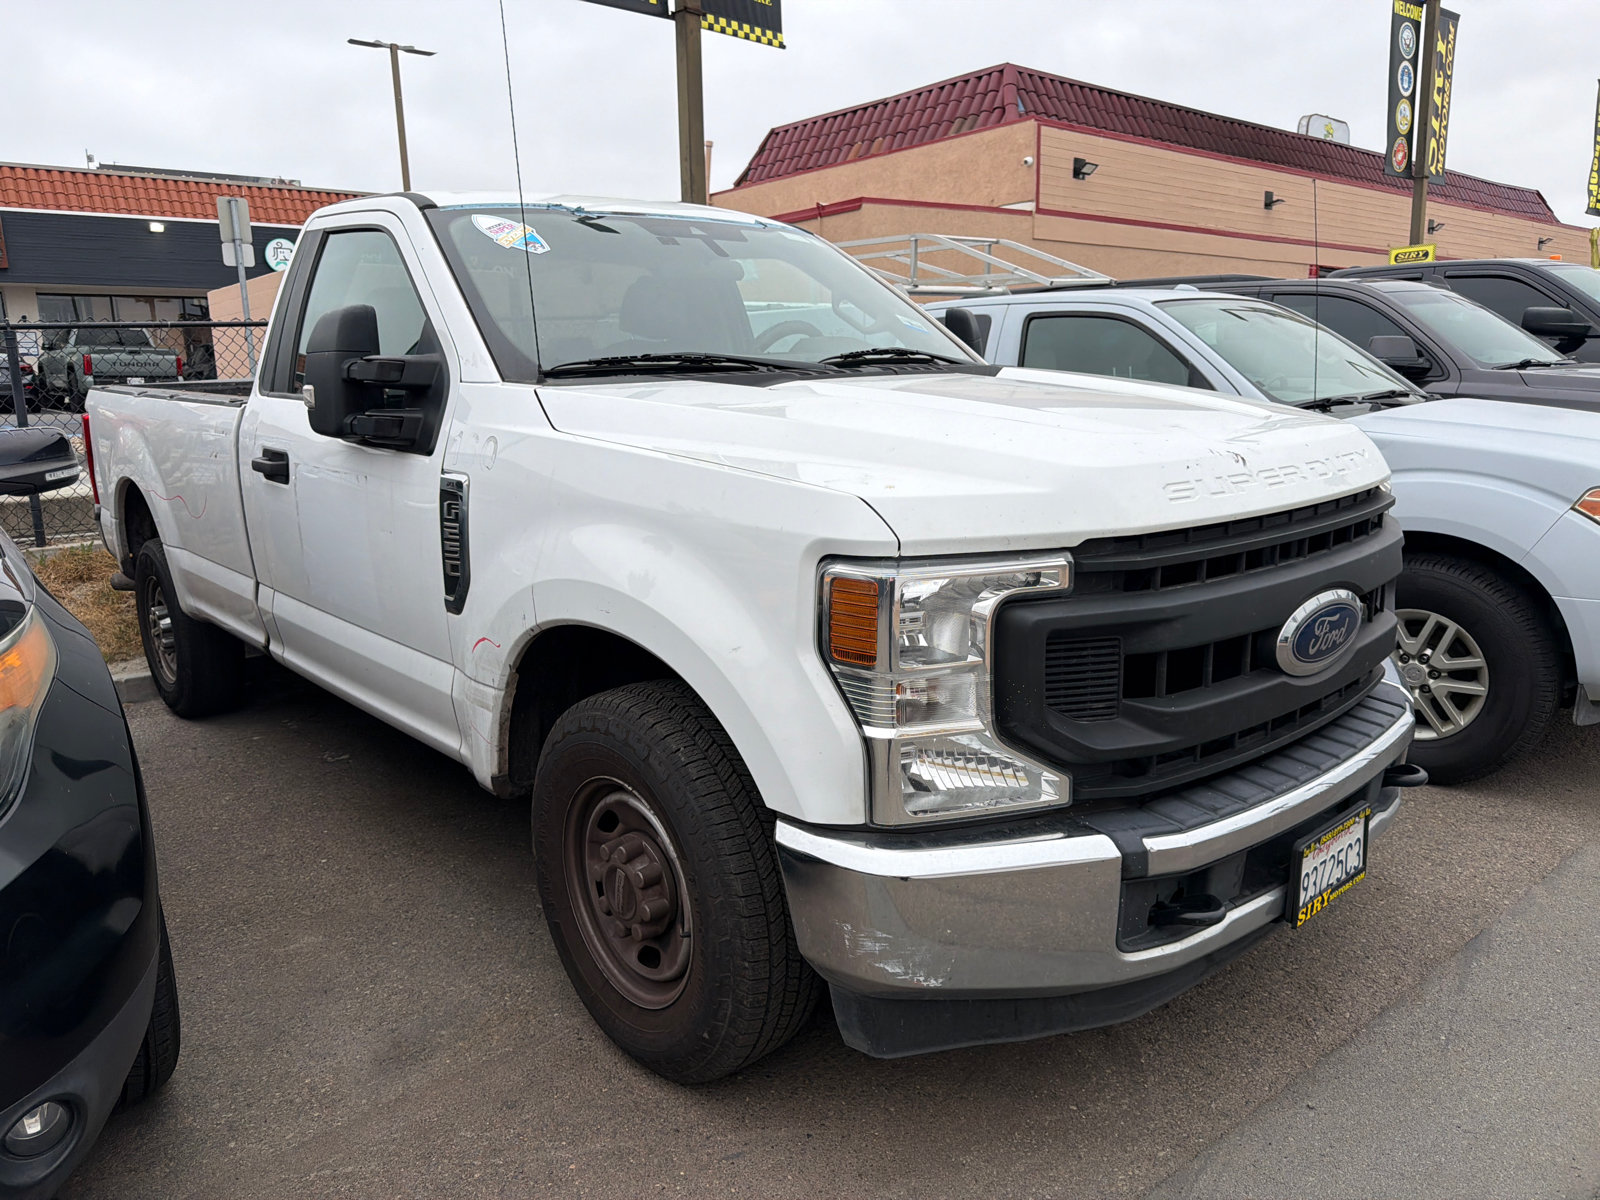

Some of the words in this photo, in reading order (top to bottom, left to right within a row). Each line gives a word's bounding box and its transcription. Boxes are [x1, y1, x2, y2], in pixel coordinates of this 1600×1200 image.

[1394, 0, 1422, 22] WELCOME
[1437, 22, 1455, 175] MOTORS.COM
[1397, 250, 1426, 260] SIRY
[1162, 463, 1308, 503] SUPER
[1309, 613, 1349, 655] Ford
[1301, 837, 1362, 908] 93725C3
[1297, 888, 1332, 927] SIRY
